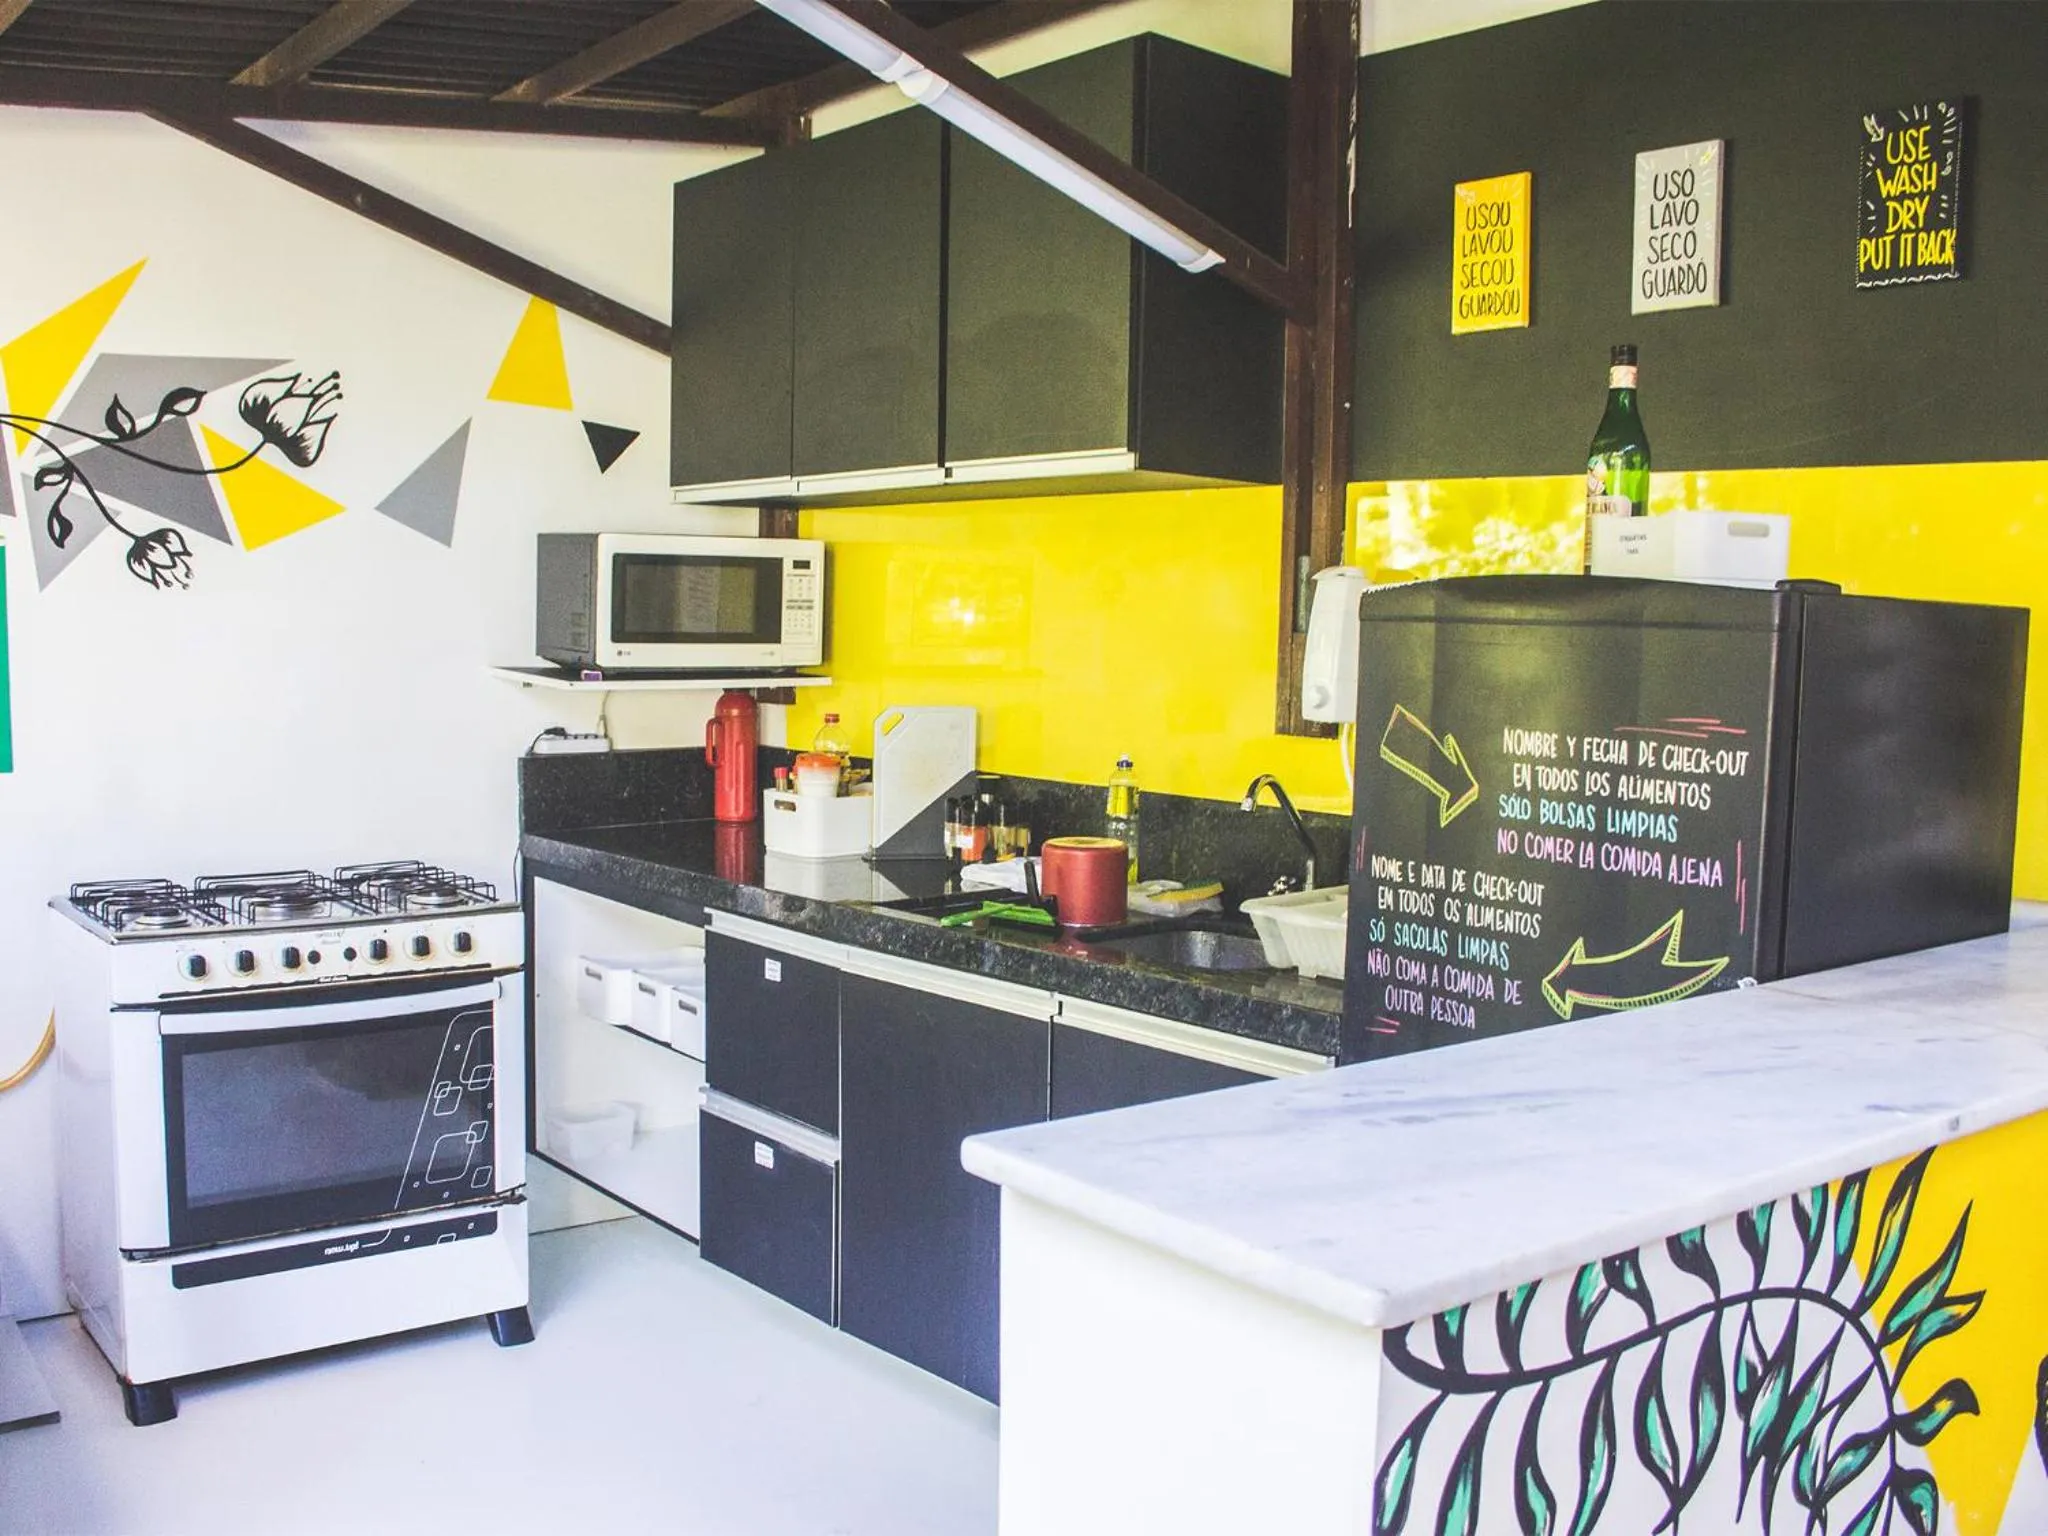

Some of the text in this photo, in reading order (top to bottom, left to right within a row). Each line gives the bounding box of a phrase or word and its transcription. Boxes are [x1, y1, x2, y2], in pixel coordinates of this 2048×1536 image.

[1886, 125, 1931, 164] USE
[1876, 161, 1937, 199] WASH
[1466, 201, 1511, 231] USOU
[1885, 195, 1930, 233] DRY
[1462, 227, 1514, 258] LAVOU
[1859, 228, 1957, 273] PUT IT BACK
[1460, 258, 1515, 289] SECOU
[1459, 288, 1521, 319] GUARDOU
[1503, 727, 1558, 759] NOMBRE
[1566, 735, 1577, 757] Y
[1583, 737, 1628, 766] FECHA
[1638, 740, 1658, 768] DE
[1513, 762, 1532, 792] EN
[1535, 765, 1579, 792] TODOS
[1585, 770, 1611, 797] LOS
[1499, 793, 1679, 843] SÓLO BOLSAS LIMPIAS
[1497, 827, 1723, 888] NO COMER LA COMIDA AJENA
[1371, 854, 1545, 907] NOME E DATA DE CHECK-OUT
[1378, 885, 1542, 939] EM TODOS OS ALIMENTOS
[1369, 916, 1510, 972] SÓ SACOLAS LIMPAS
[1367, 947, 1391, 978] NÃO
[1395, 956, 1427, 986] COMA
[1431, 964, 1439, 989] A
[1504, 978, 1523, 1006] DE
[1385, 985, 1476, 1030] OUTRA PESSOA
